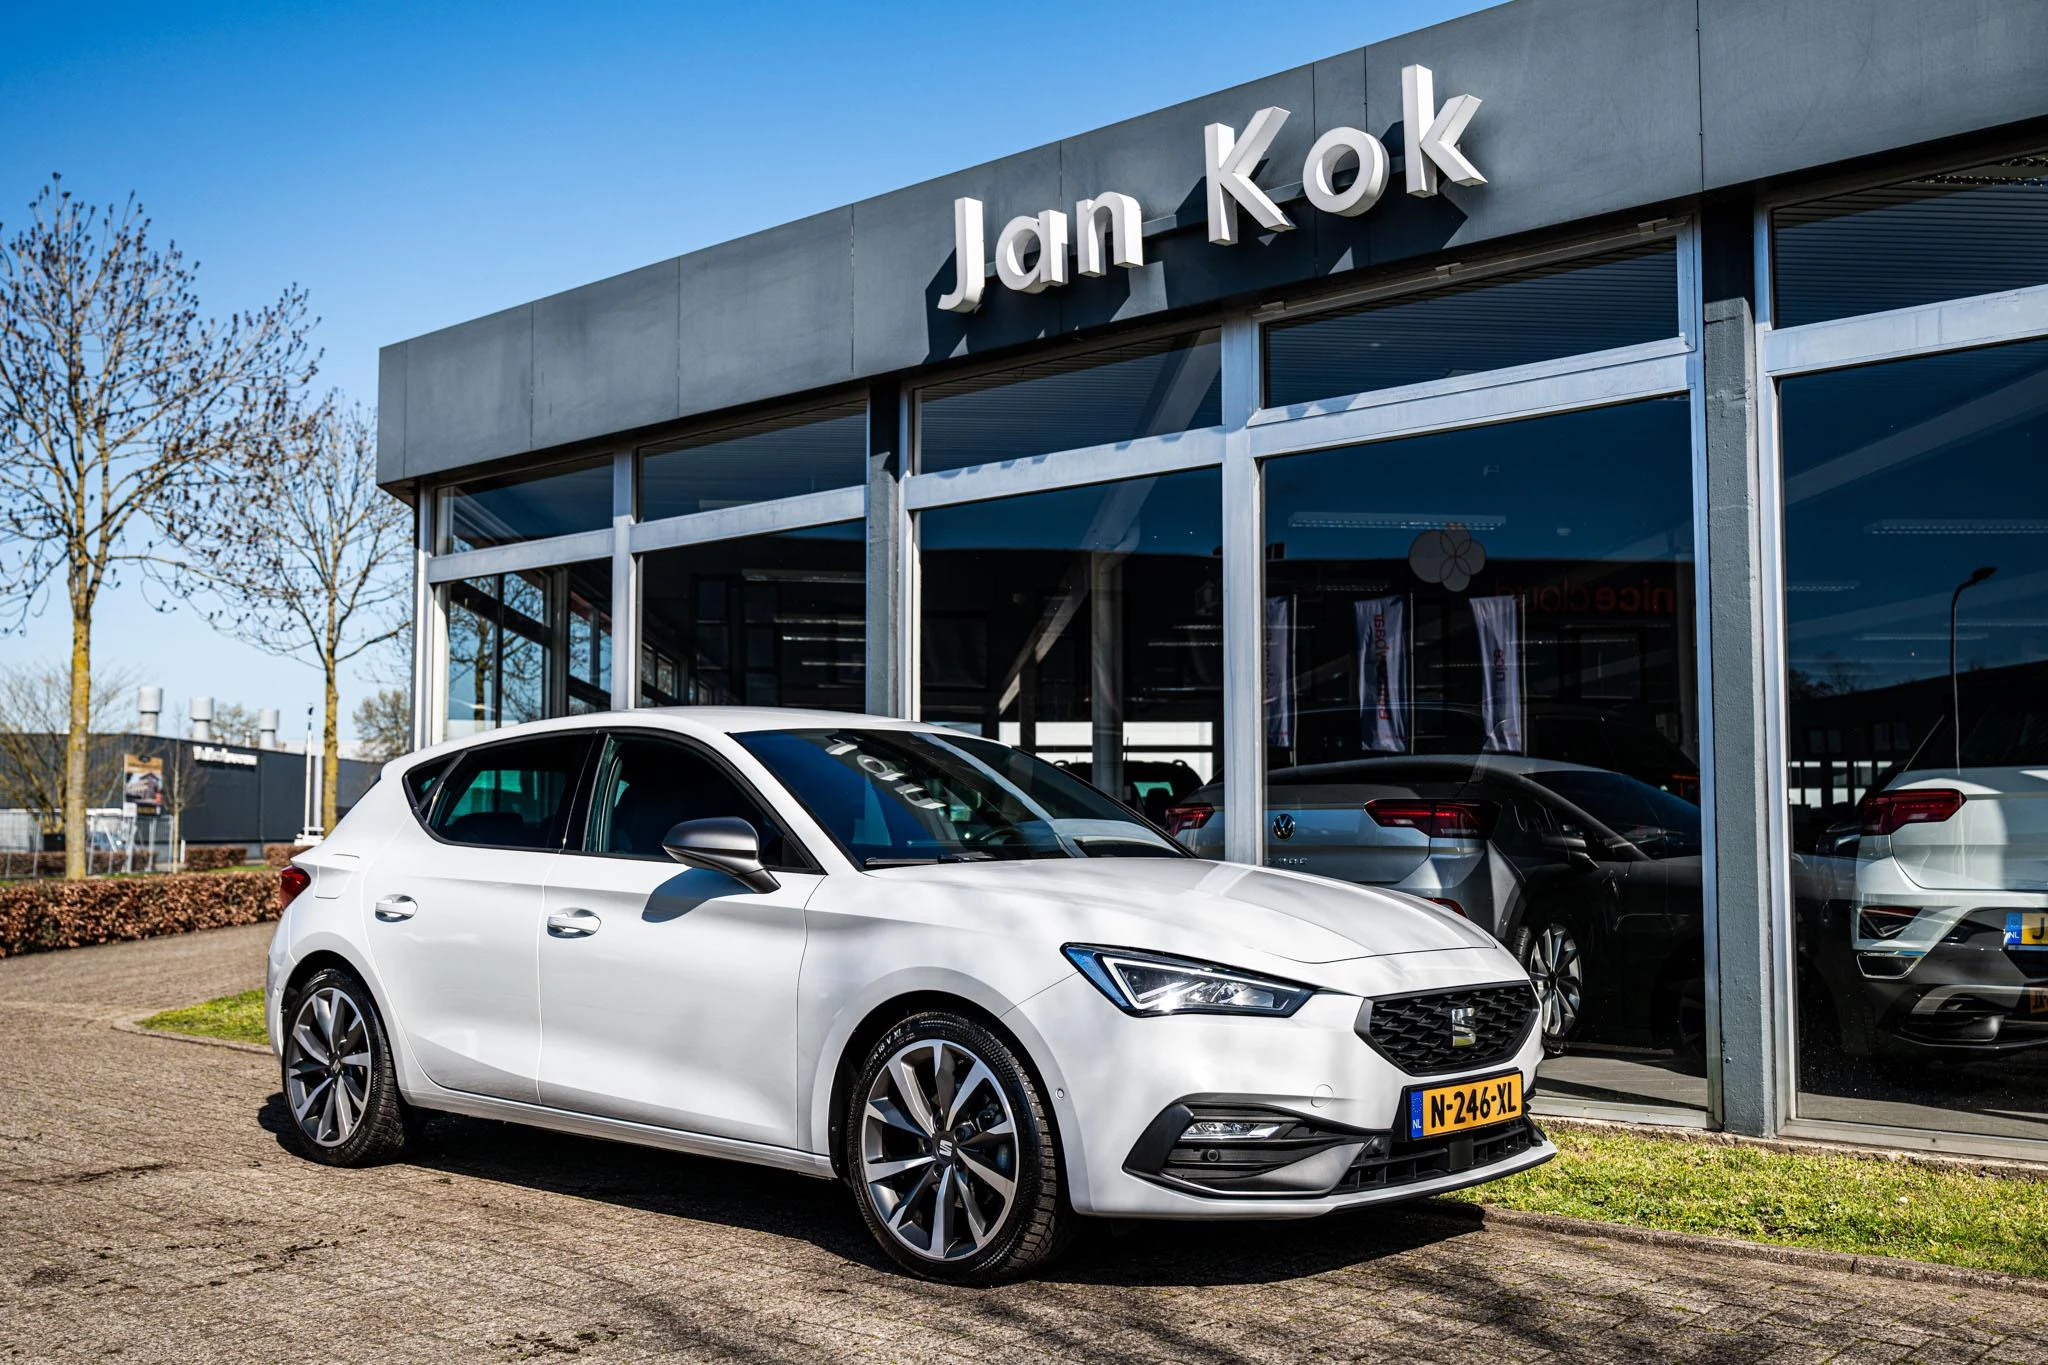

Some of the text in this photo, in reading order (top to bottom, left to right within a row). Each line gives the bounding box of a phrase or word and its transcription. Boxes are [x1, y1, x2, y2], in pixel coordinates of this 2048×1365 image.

[937, 64, 1488, 313] Jan Kok
[2008, 931, 2019, 939] NL
[1430, 1081, 1517, 1129] N-246-XL
[1412, 1119, 1421, 1130] NL
